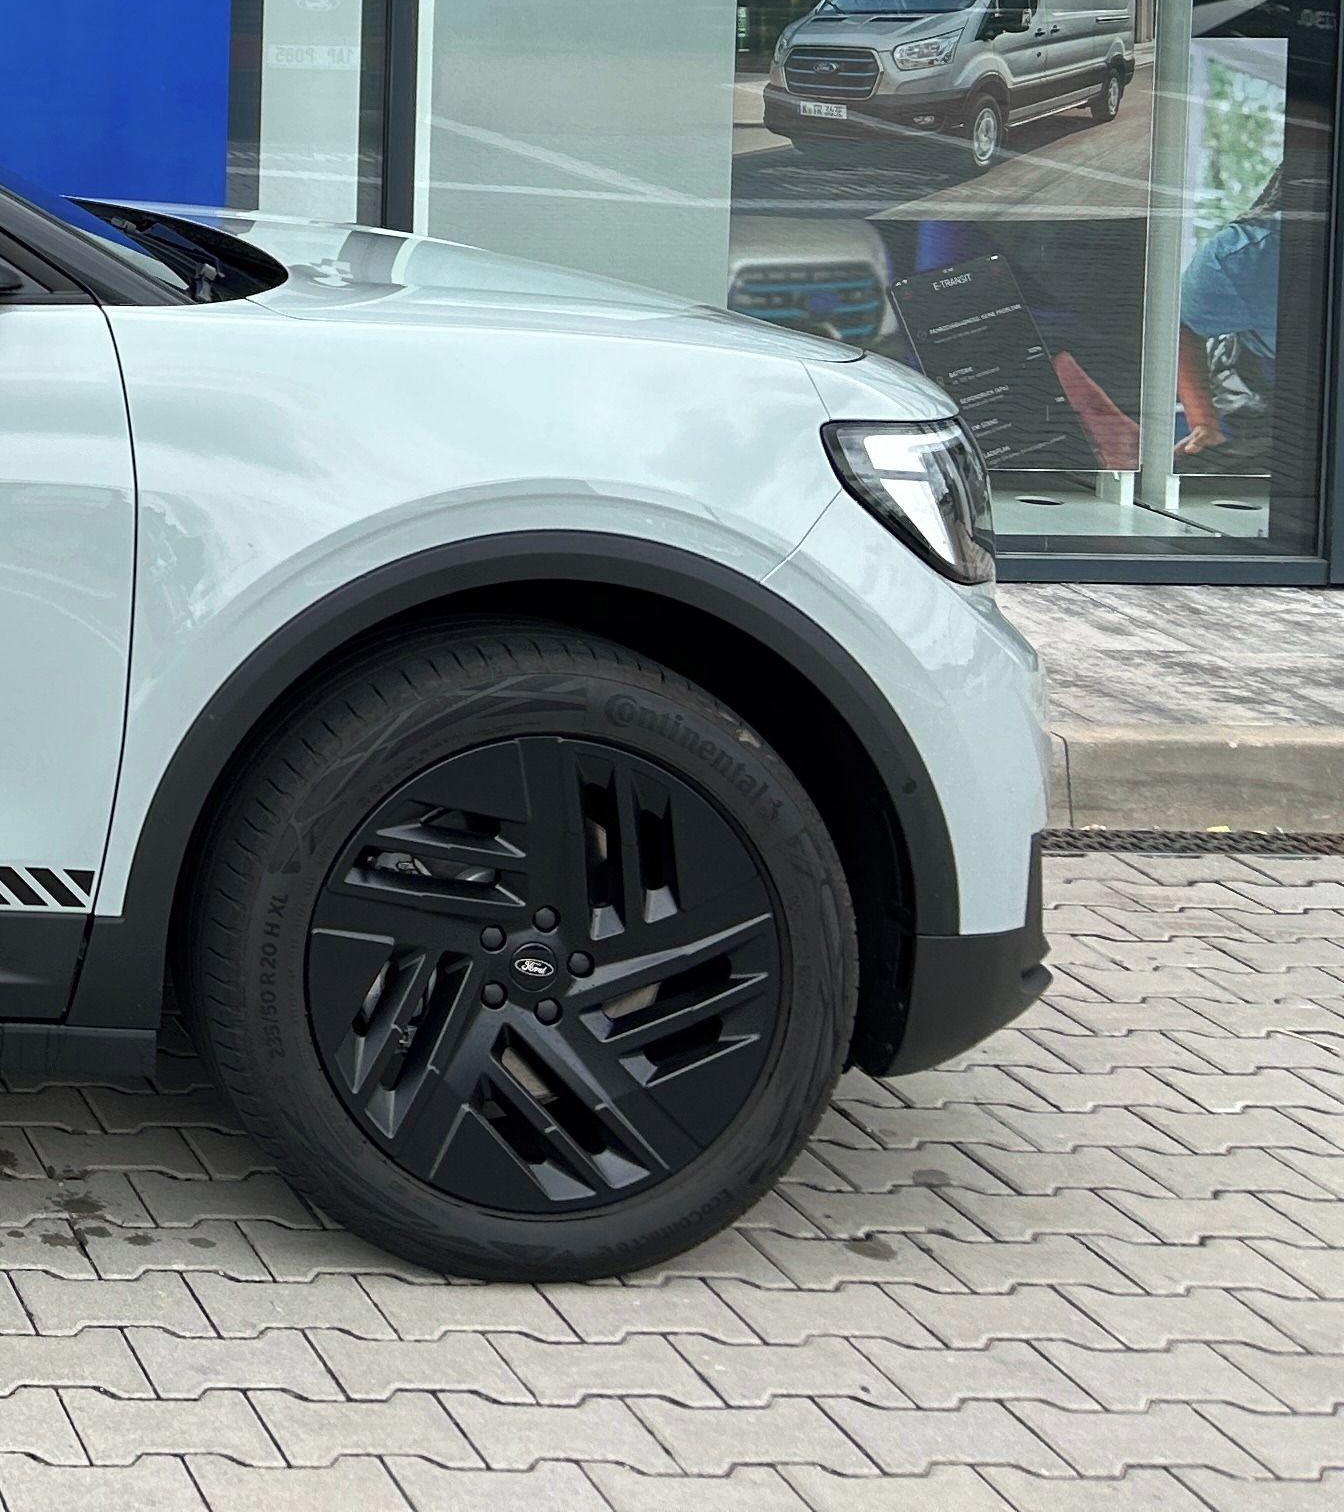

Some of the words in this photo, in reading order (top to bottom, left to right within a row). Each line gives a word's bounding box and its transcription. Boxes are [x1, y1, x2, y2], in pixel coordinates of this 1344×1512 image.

[603, 693, 771, 805] Continental
[521, 960, 548, 974] Ford
[259, 990, 287, 1060] 235/50
